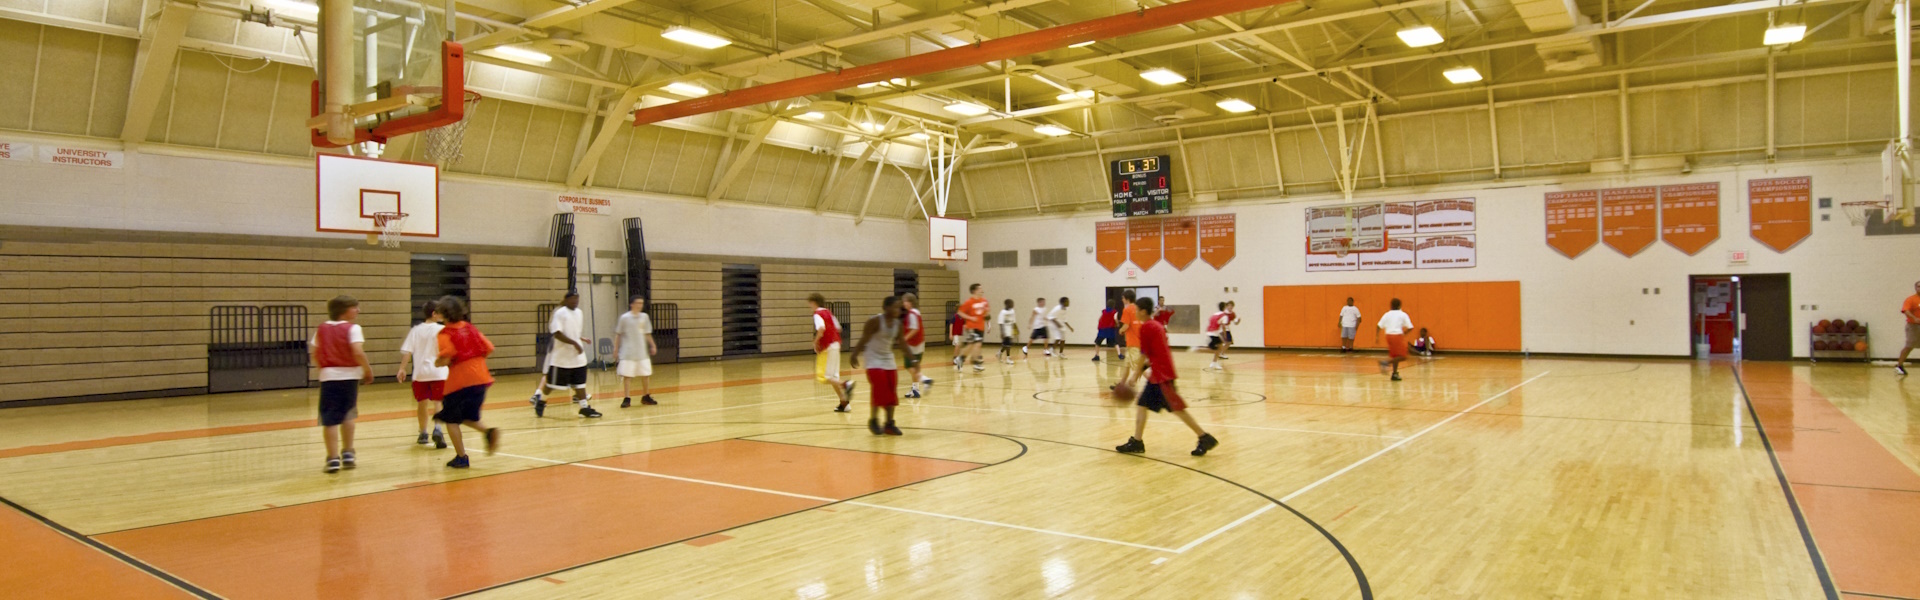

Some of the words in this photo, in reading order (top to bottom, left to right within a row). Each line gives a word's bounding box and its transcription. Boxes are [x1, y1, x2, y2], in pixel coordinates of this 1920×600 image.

[56, 148, 108, 158] UNIVERSITY
[52, 156, 112, 166] INSTRUCTORS
[1122, 180, 1130, 192] 0
[1158, 176, 1166, 188] 0
[1604, 188, 1653, 196] BASEBALL
[1751, 184, 1808, 192] CHAMPIONSHIPS
[1547, 191, 1595, 199] SOFTBALL
[559, 195, 587, 205] CORPORATE
[589, 198, 611, 206] BUSINESS
[573, 205, 598, 213] SPONSORS
